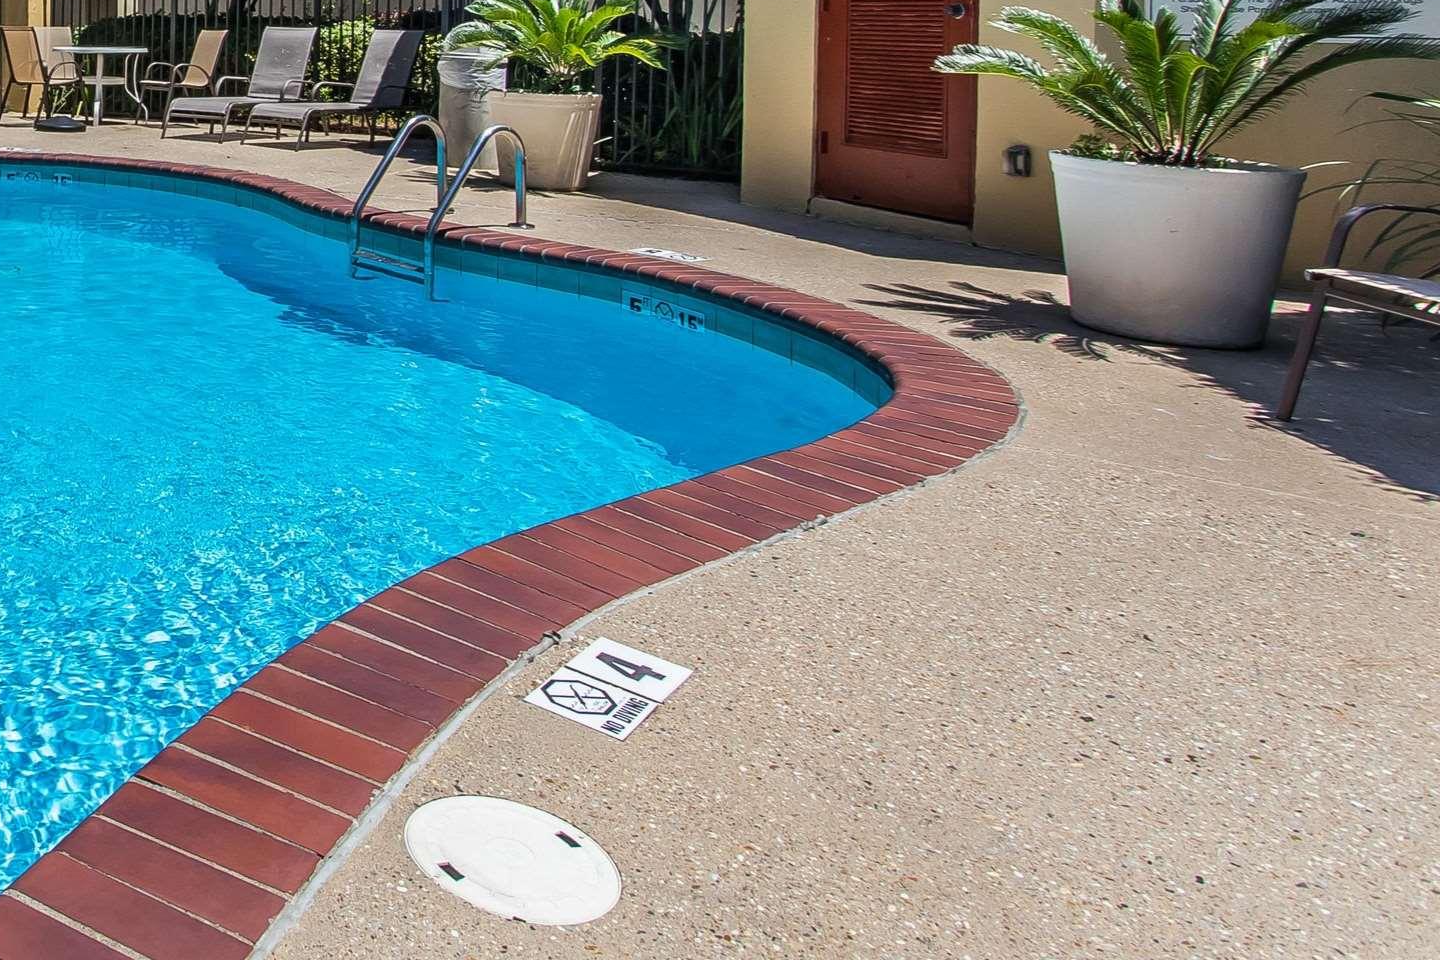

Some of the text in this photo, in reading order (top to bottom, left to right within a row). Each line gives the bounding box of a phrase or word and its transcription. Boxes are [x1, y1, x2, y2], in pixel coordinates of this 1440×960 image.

[595, 651, 667, 682] 4
[600, 696, 650, 735] NO DIVING
